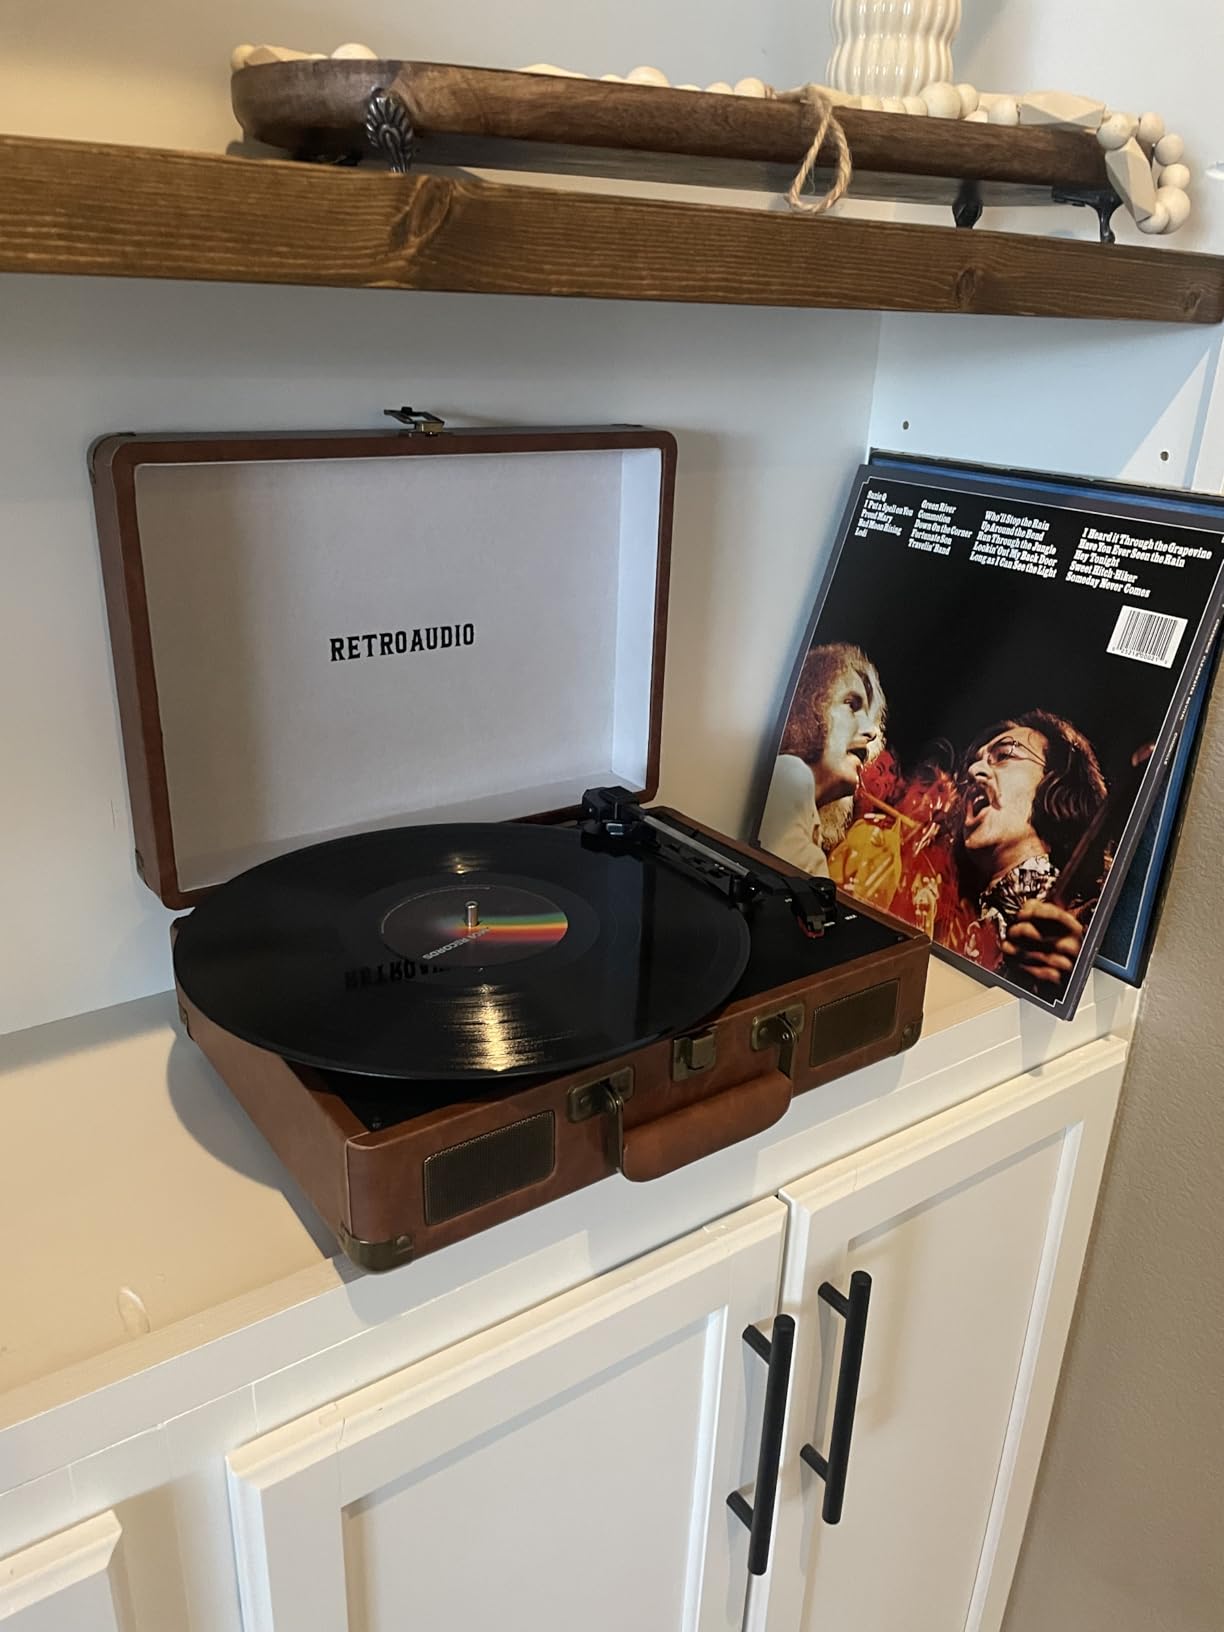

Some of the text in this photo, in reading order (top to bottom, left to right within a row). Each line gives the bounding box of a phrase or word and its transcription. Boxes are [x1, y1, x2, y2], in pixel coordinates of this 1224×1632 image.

[882, 492, 887, 502] Q
[861, 508, 893, 524] Proud Mary
[864, 499, 868, 508] I
[903, 506, 914, 516] You
[921, 500, 956, 514] Green River
[918, 510, 951, 524] Commotion
[984, 510, 1050, 531] Who'll Stop the Rain
[854, 527, 868, 537] Lodi
[883, 523, 902, 536] Rising
[911, 529, 952, 545] Fortunate Son
[914, 519, 973, 538] Down On the Corner
[981, 521, 1045, 542] Up Around the Bend
[933, 544, 951, 555] Band
[977, 531, 1057, 555] Run Through the Jungle
[1082, 527, 1212, 560] I Heard it Through the Grapevine
[973, 541, 1058, 567] Lookin' Out My Back Door
[1073, 549, 1120, 568] Hey Tonight
[1078, 538, 1185, 568] Have You Ever Seen the Rain
[969, 551, 1057, 578] Long as I Can See the Light
[1069, 560, 1138, 583] Sweet Hitch-Hiker
[1065, 571, 1151, 598] Someday Never Comes
[329, 623, 475, 661] RETROAUDIO
